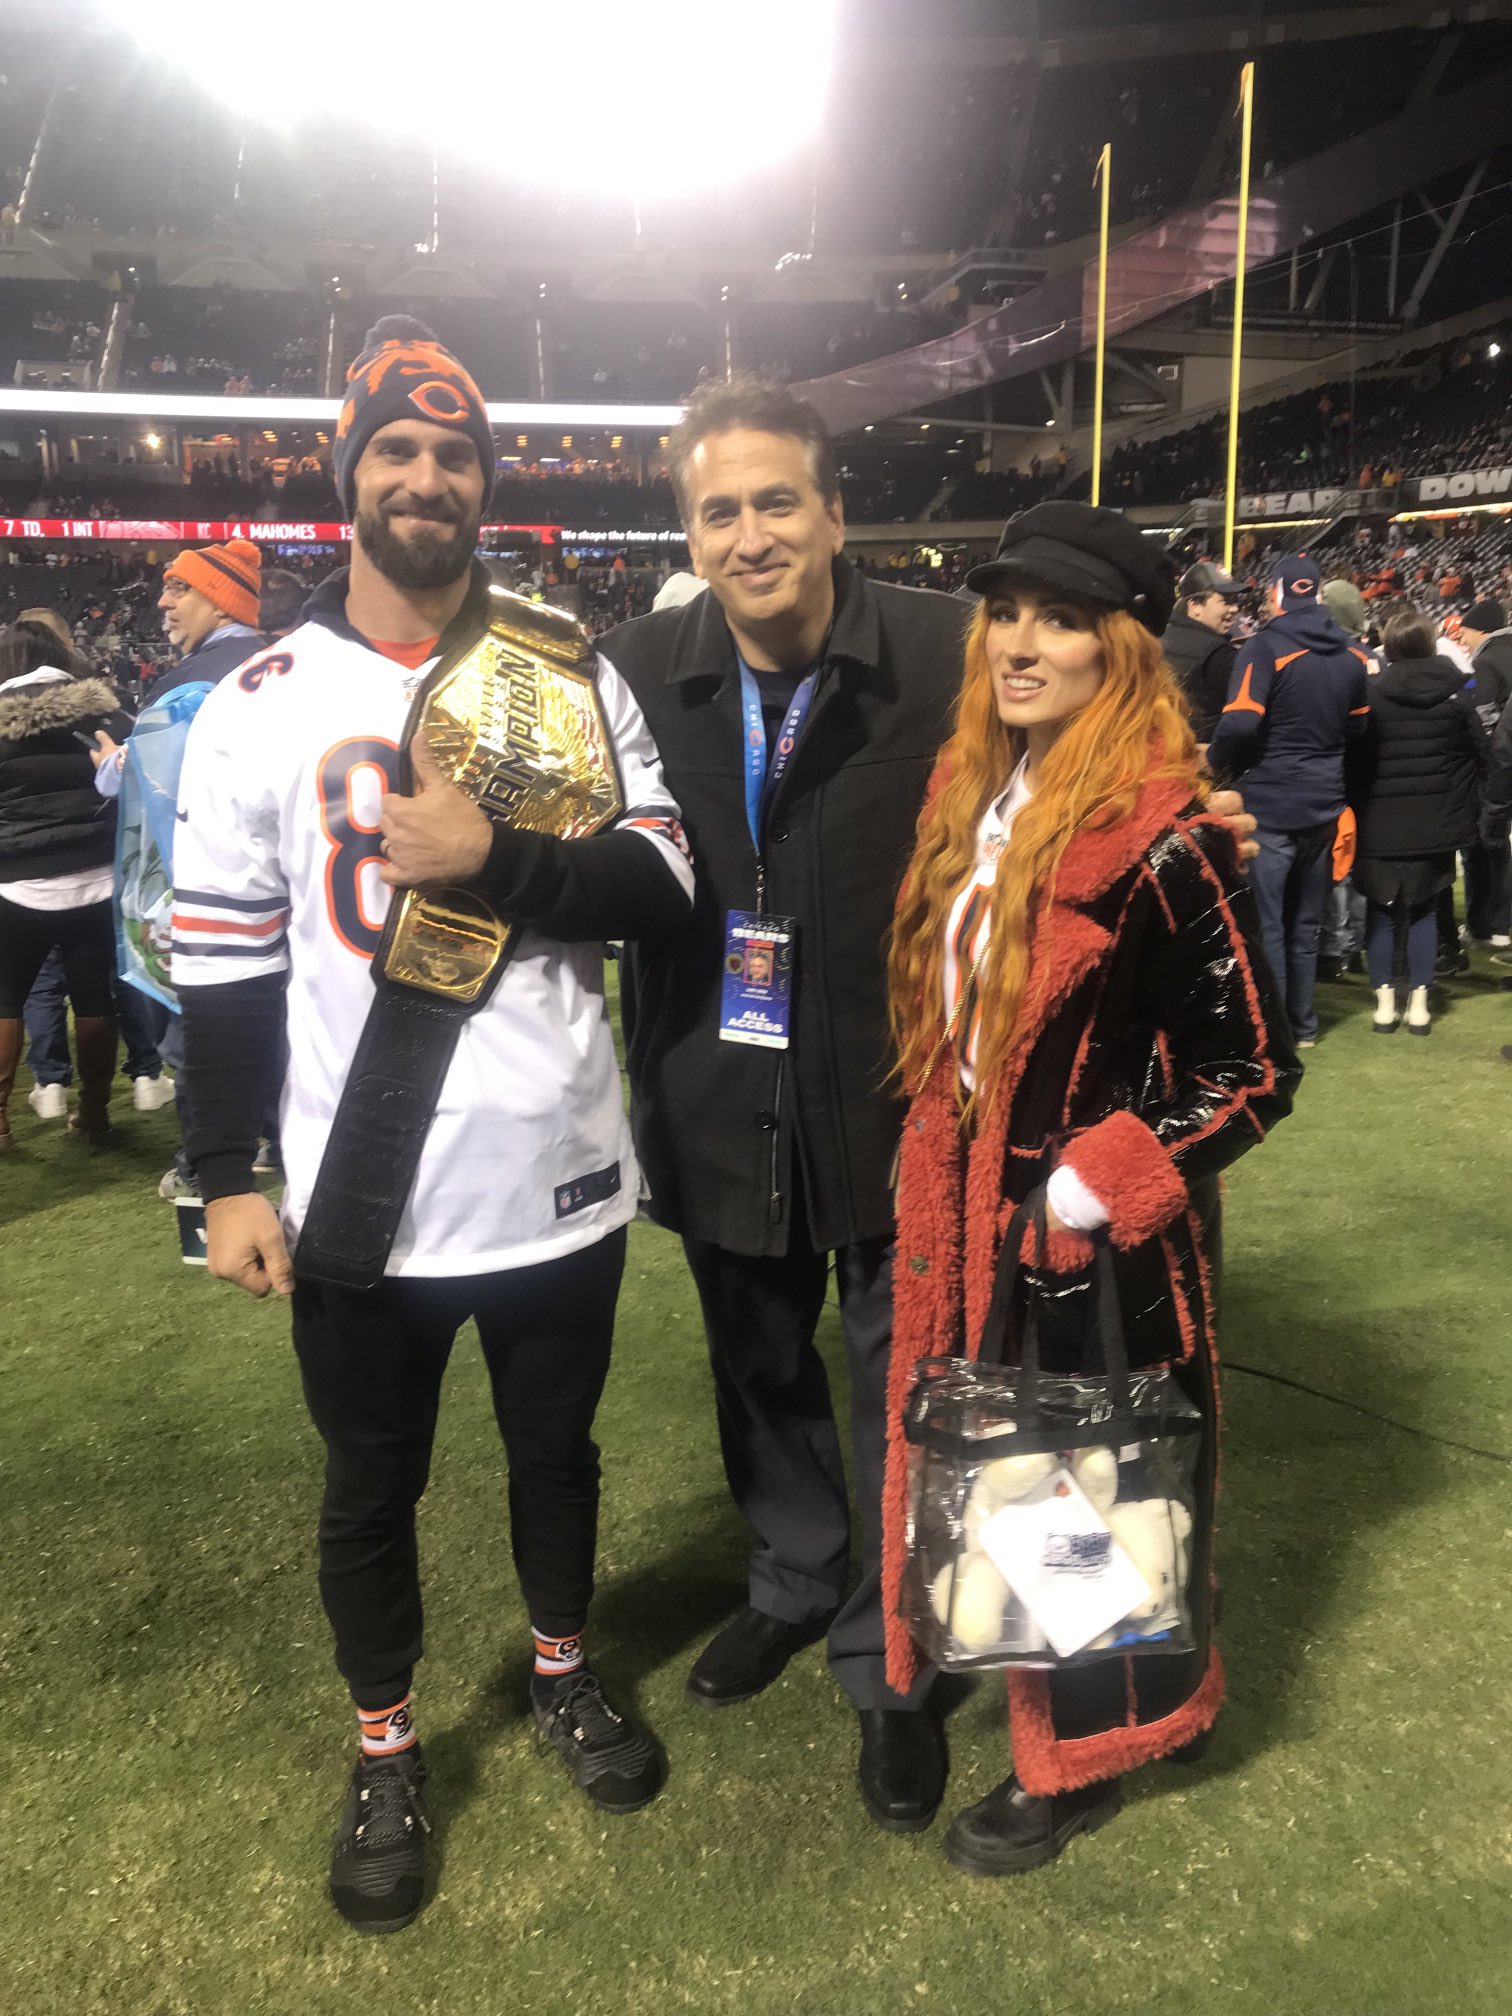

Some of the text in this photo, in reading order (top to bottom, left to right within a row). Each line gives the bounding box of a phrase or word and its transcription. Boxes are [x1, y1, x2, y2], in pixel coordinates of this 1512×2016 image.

[1239, 468, 1512, 519] BEAR DOW
[3, 519, 15, 536] 7
[60, 521, 70, 537] 1
[72, 521, 95, 538] INT
[249, 524, 317, 540] MAHOMES
[577, 529, 607, 542] shape
[608, 529, 625, 541] the
[626, 529, 657, 541] future
[658, 530, 670, 541] of
[773, 708, 801, 779] CHICAGO
[731, 927, 790, 944] BEARS
[742, 1010, 770, 1023] ALL
[726, 1017, 784, 1034] ACCESS
